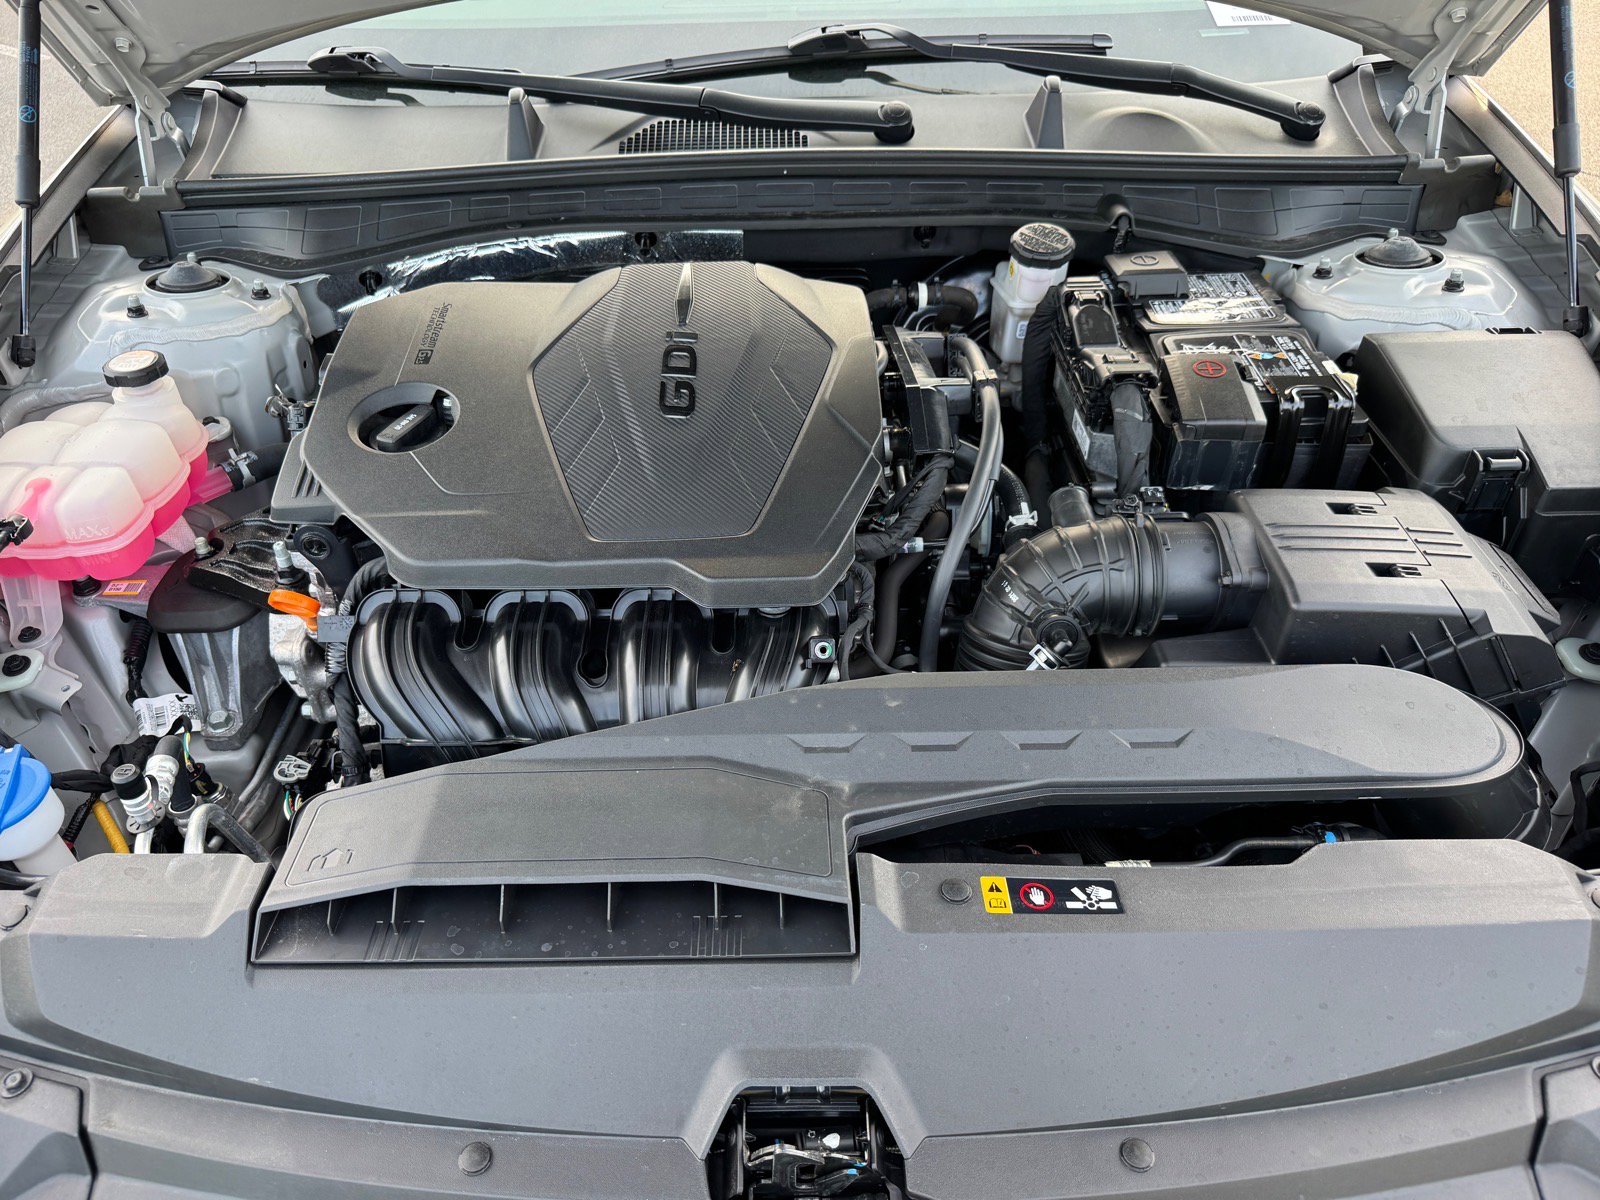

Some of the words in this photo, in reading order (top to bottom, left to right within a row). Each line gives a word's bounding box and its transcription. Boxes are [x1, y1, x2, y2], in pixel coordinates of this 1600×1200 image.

[421, 306, 440, 347] TECHNOLOGY
[428, 302, 452, 348] Smartstream
[659, 331, 698, 419] GDi
[65, 525, 102, 540] MAX
[80, 554, 112, 567] MIN
